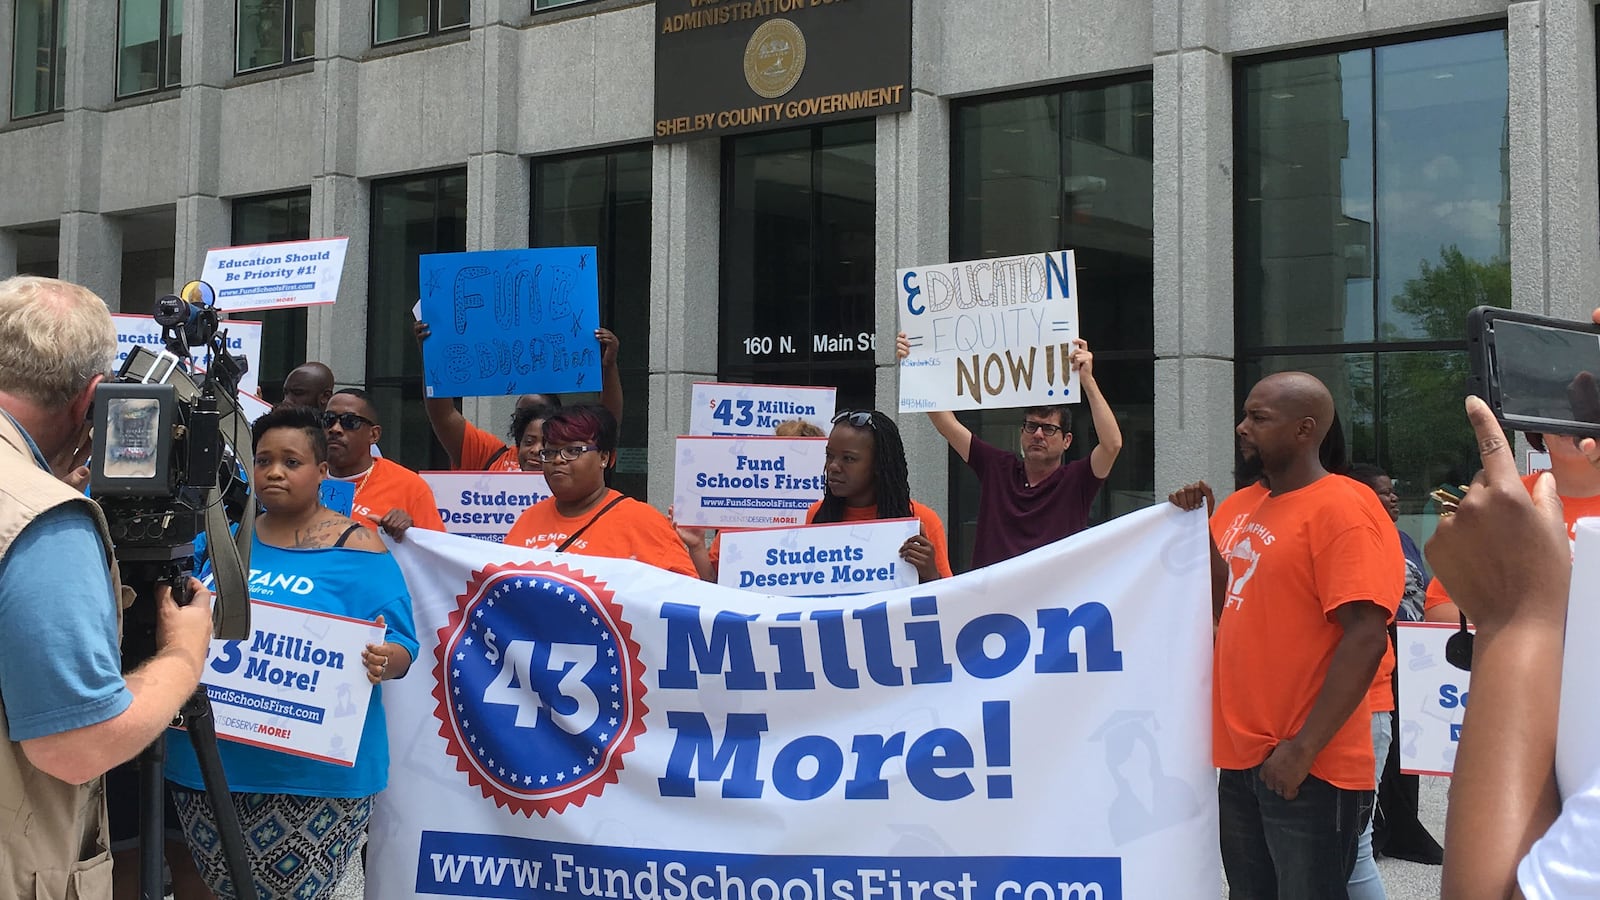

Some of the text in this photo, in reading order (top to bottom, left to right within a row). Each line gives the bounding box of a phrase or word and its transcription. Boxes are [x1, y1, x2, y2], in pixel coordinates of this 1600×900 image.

[662, 0, 804, 33] ADMINISTRATION
[656, 85, 904, 136] SHELBY COUNTY GOVERNMENT
[217, 251, 330, 270] Education Should
[225, 265, 317, 281] Be Priority #1!
[903, 251, 1070, 316] EDUCATION
[117, 332, 166, 345] ucatio
[743, 336, 773, 354] 160
[780, 335, 796, 353] N.
[813, 334, 853, 352] Main
[932, 307, 1045, 353] EQUITY
[710, 399, 754, 427] $43
[757, 400, 816, 415] Million
[736, 455, 785, 471] Fund
[696, 472, 826, 490] Schools First!
[437, 508, 515, 524] Deserve
[766, 545, 863, 566] Students
[248, 569, 314, 595] TAND
[739, 562, 895, 588] Deserve More!
[248, 584, 274, 596] ildren
[249, 630, 344, 670] Million
[657, 596, 1124, 691] Million
[243, 656, 320, 692] More!
[482, 625, 601, 736] $43
[206, 687, 320, 721] undSchoolsFirst.com
[656, 700, 1014, 801] More!
[430, 853, 1105, 900] www.FundSchoolsFirstcom
